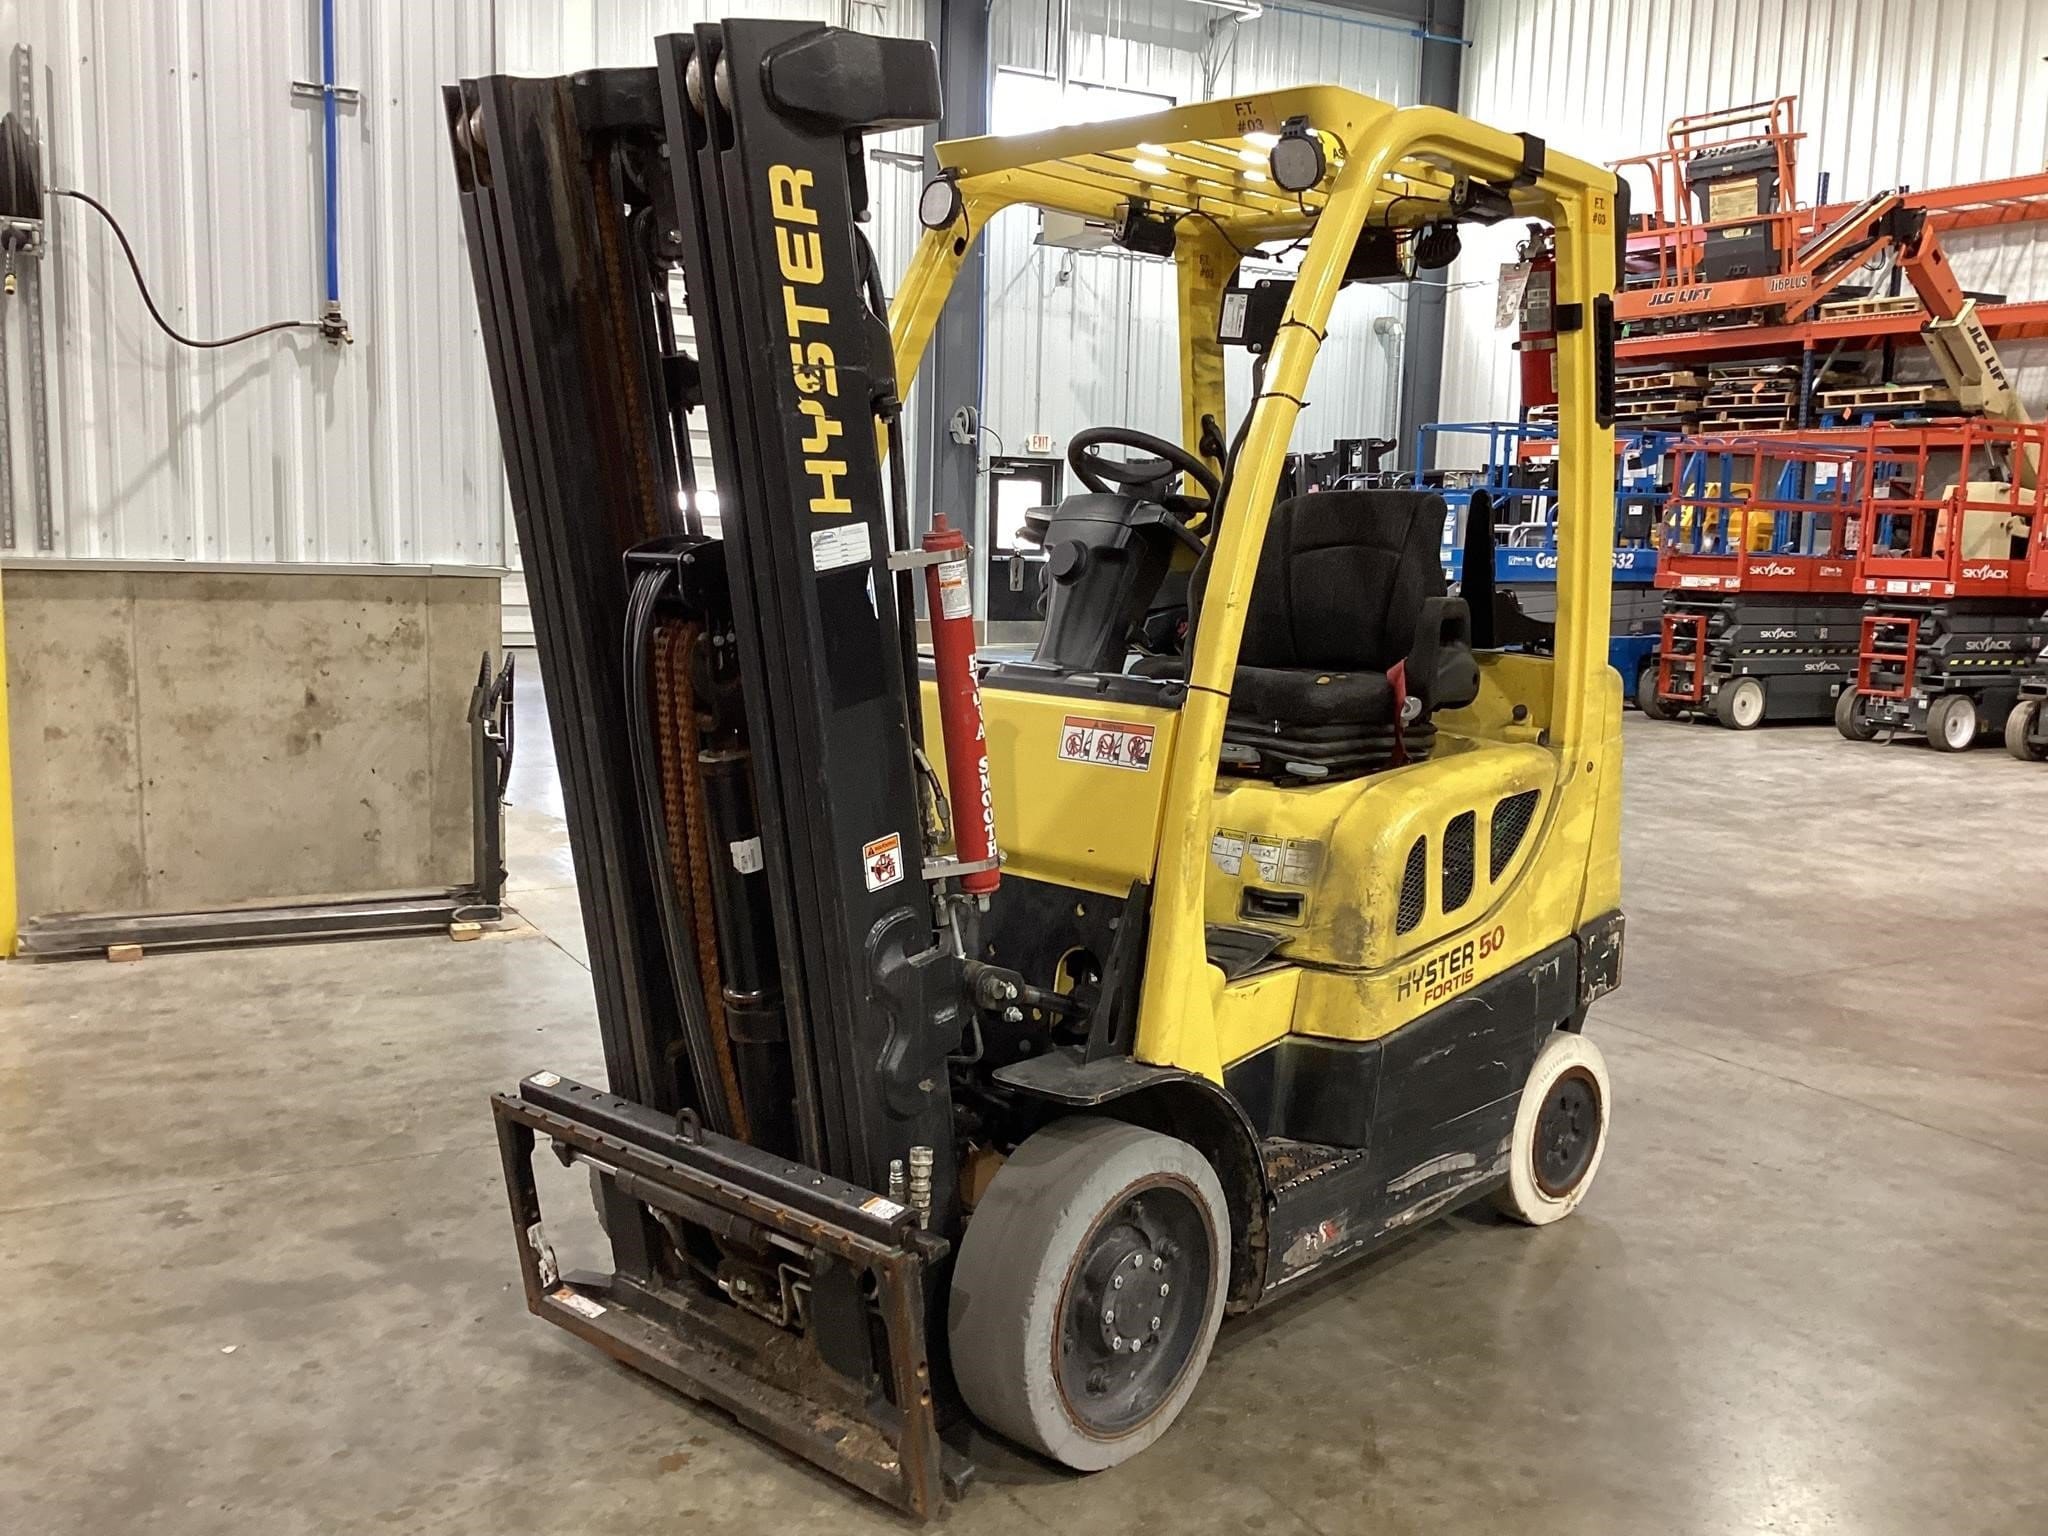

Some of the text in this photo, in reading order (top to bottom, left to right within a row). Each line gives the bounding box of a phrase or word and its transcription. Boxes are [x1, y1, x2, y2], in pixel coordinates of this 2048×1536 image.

[1648, 287, 1712, 306] JLG LIFT
[768, 164, 852, 513] HYSTER
[1967, 326, 2009, 391] JLG LIFT
[1033, 435, 1048, 449] EXIT
[1750, 562, 1796, 577] SKYJACK
[1962, 564, 2009, 580] SKYJACK
[978, 756, 997, 858] SMOOTH
[1397, 925, 1505, 1002] HYSTER 50
[1424, 968, 1474, 1006] FORTIS
